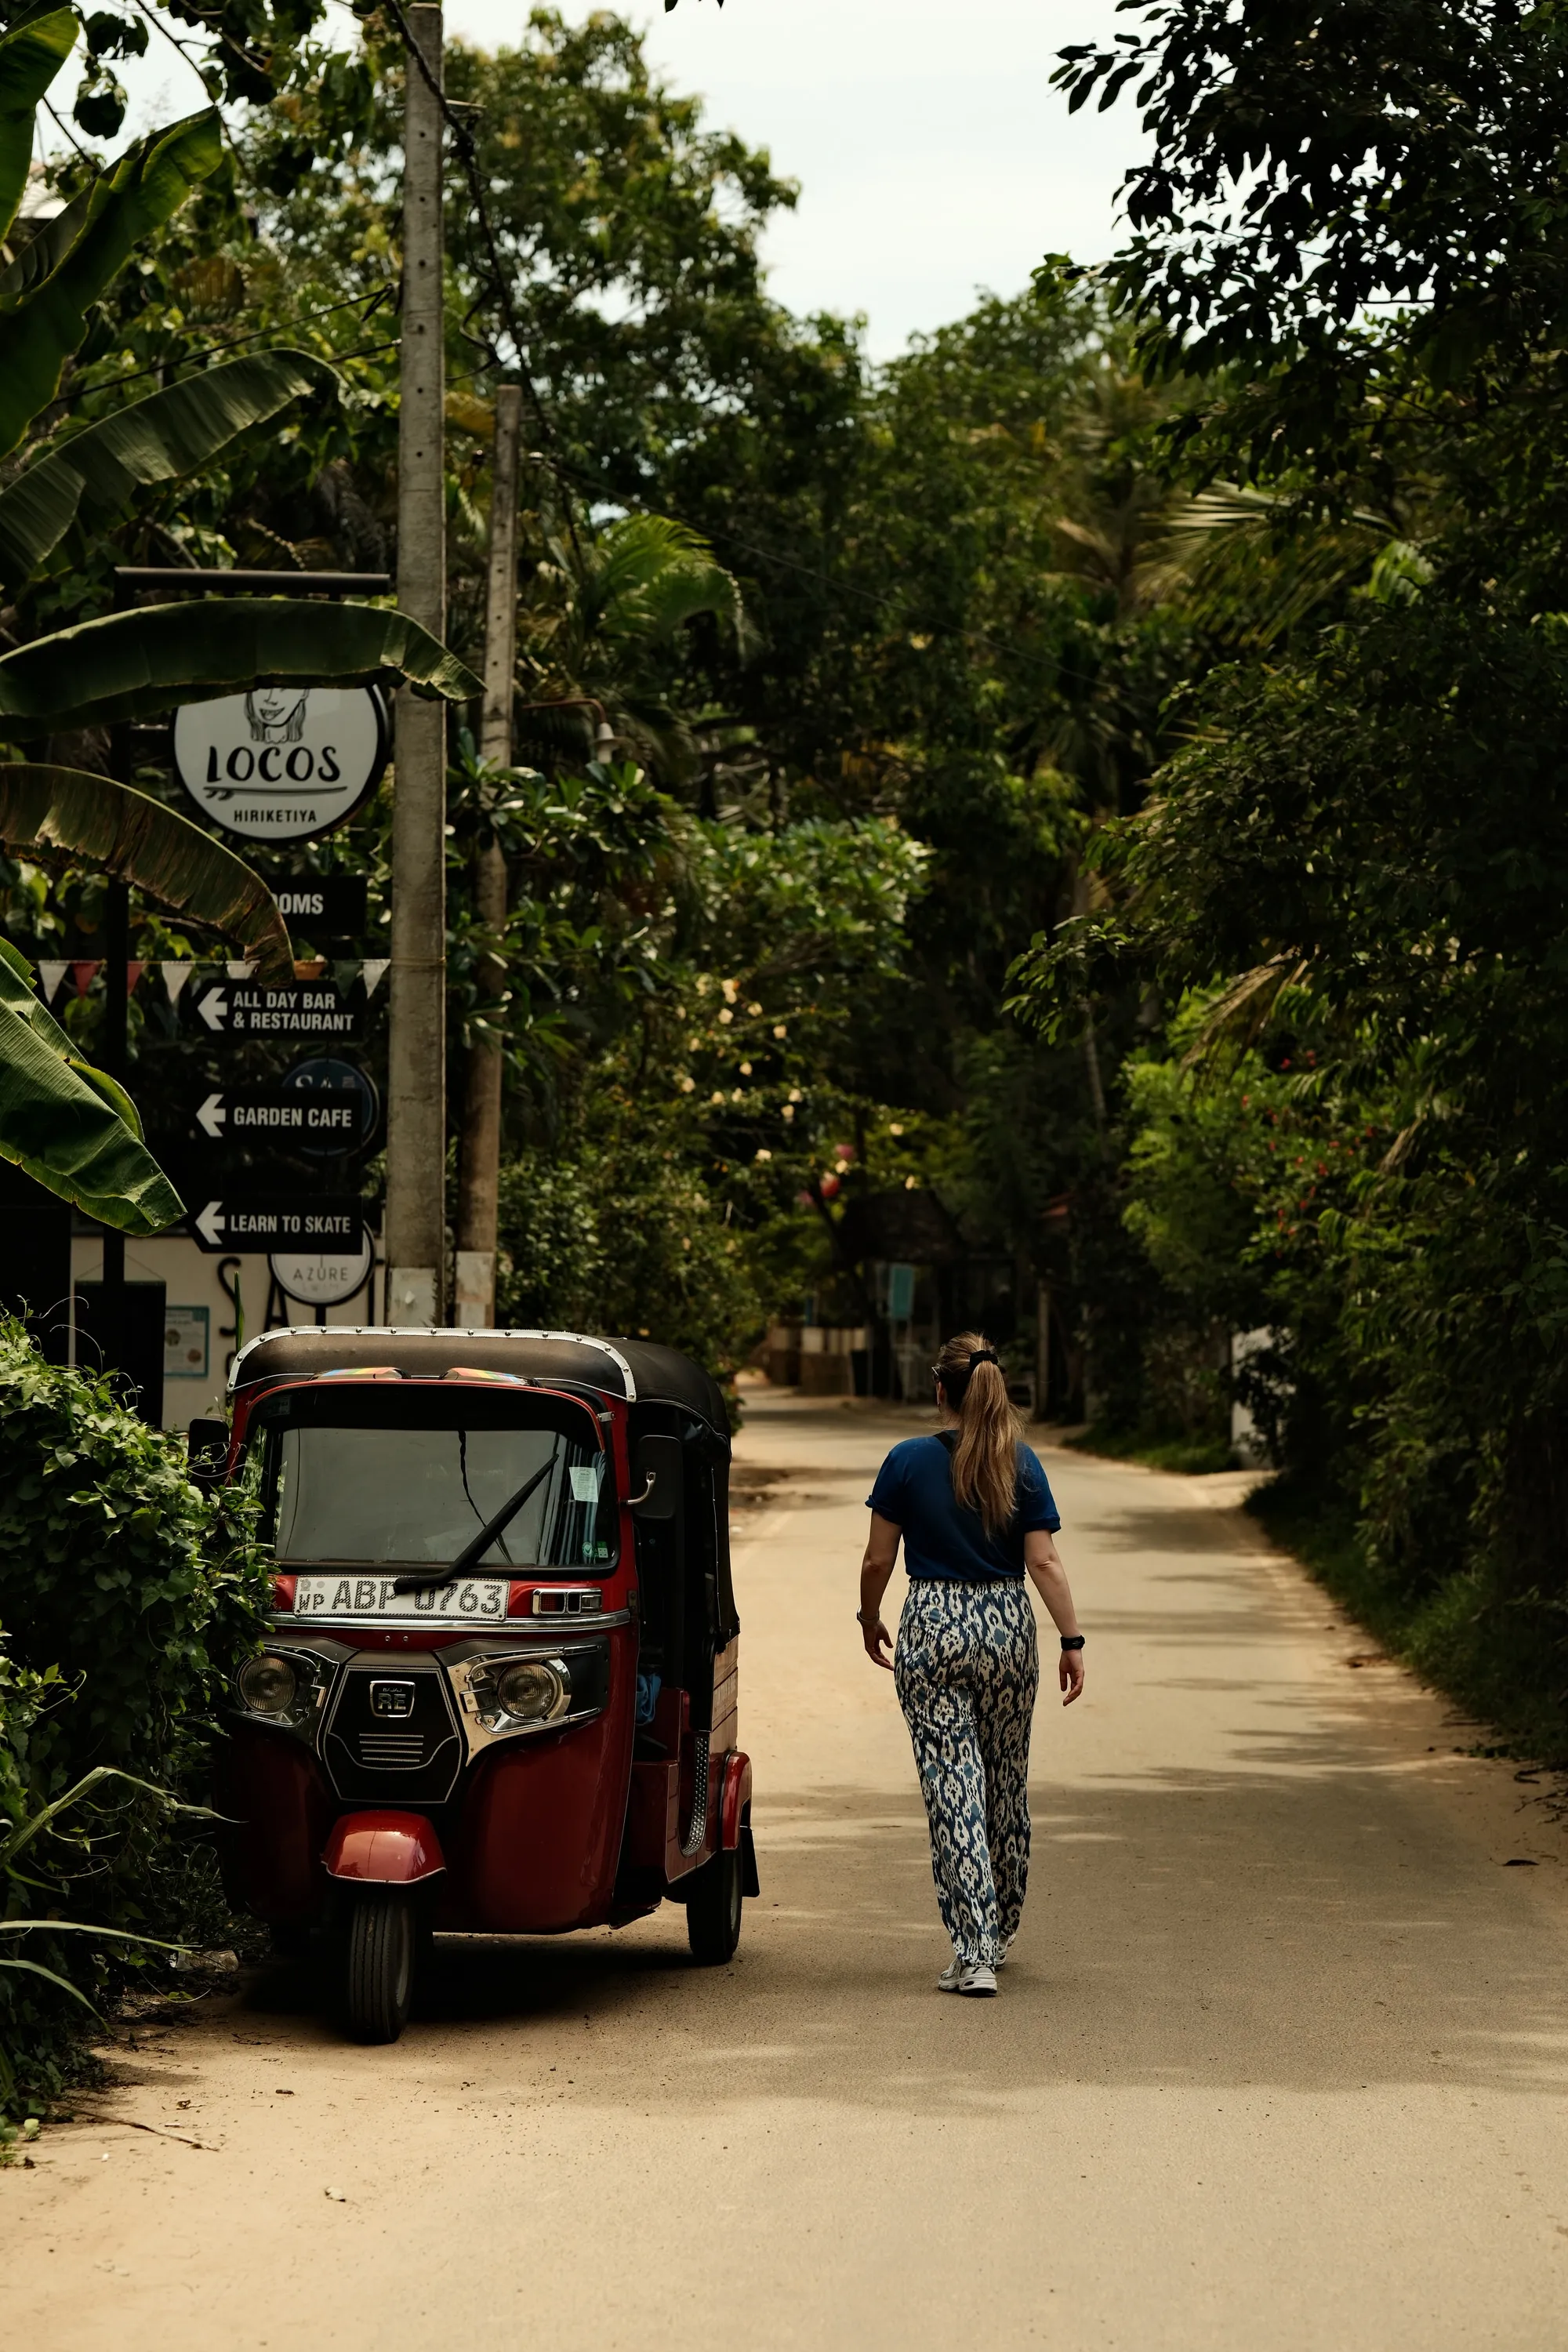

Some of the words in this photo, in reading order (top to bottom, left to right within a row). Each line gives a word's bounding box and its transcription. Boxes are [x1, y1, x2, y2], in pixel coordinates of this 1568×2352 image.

[206, 746, 340, 782] LOCOS
[234, 809, 317, 823] HIRIKETIYA
[272, 892, 324, 915] OMS
[233, 991, 261, 1007] ALL
[266, 992, 298, 1009] DAY
[303, 993, 336, 1010] BAR
[233, 1011, 245, 1029] &
[250, 1012, 354, 1031] RESTAURANT
[233, 1106, 303, 1127] GARDEN
[307, 1108, 352, 1128] CAFE
[230, 1214, 278, 1232] LEARN
[281, 1215, 301, 1233] TO
[304, 1216, 351, 1234] SKATE
[292, 1267, 348, 1281] AZURE
[299, 1593, 325, 1610] WP
[332, 1580, 398, 1610] ABP
[415, 1582, 503, 1613] 0763
[378, 1693, 406, 1711] RE
